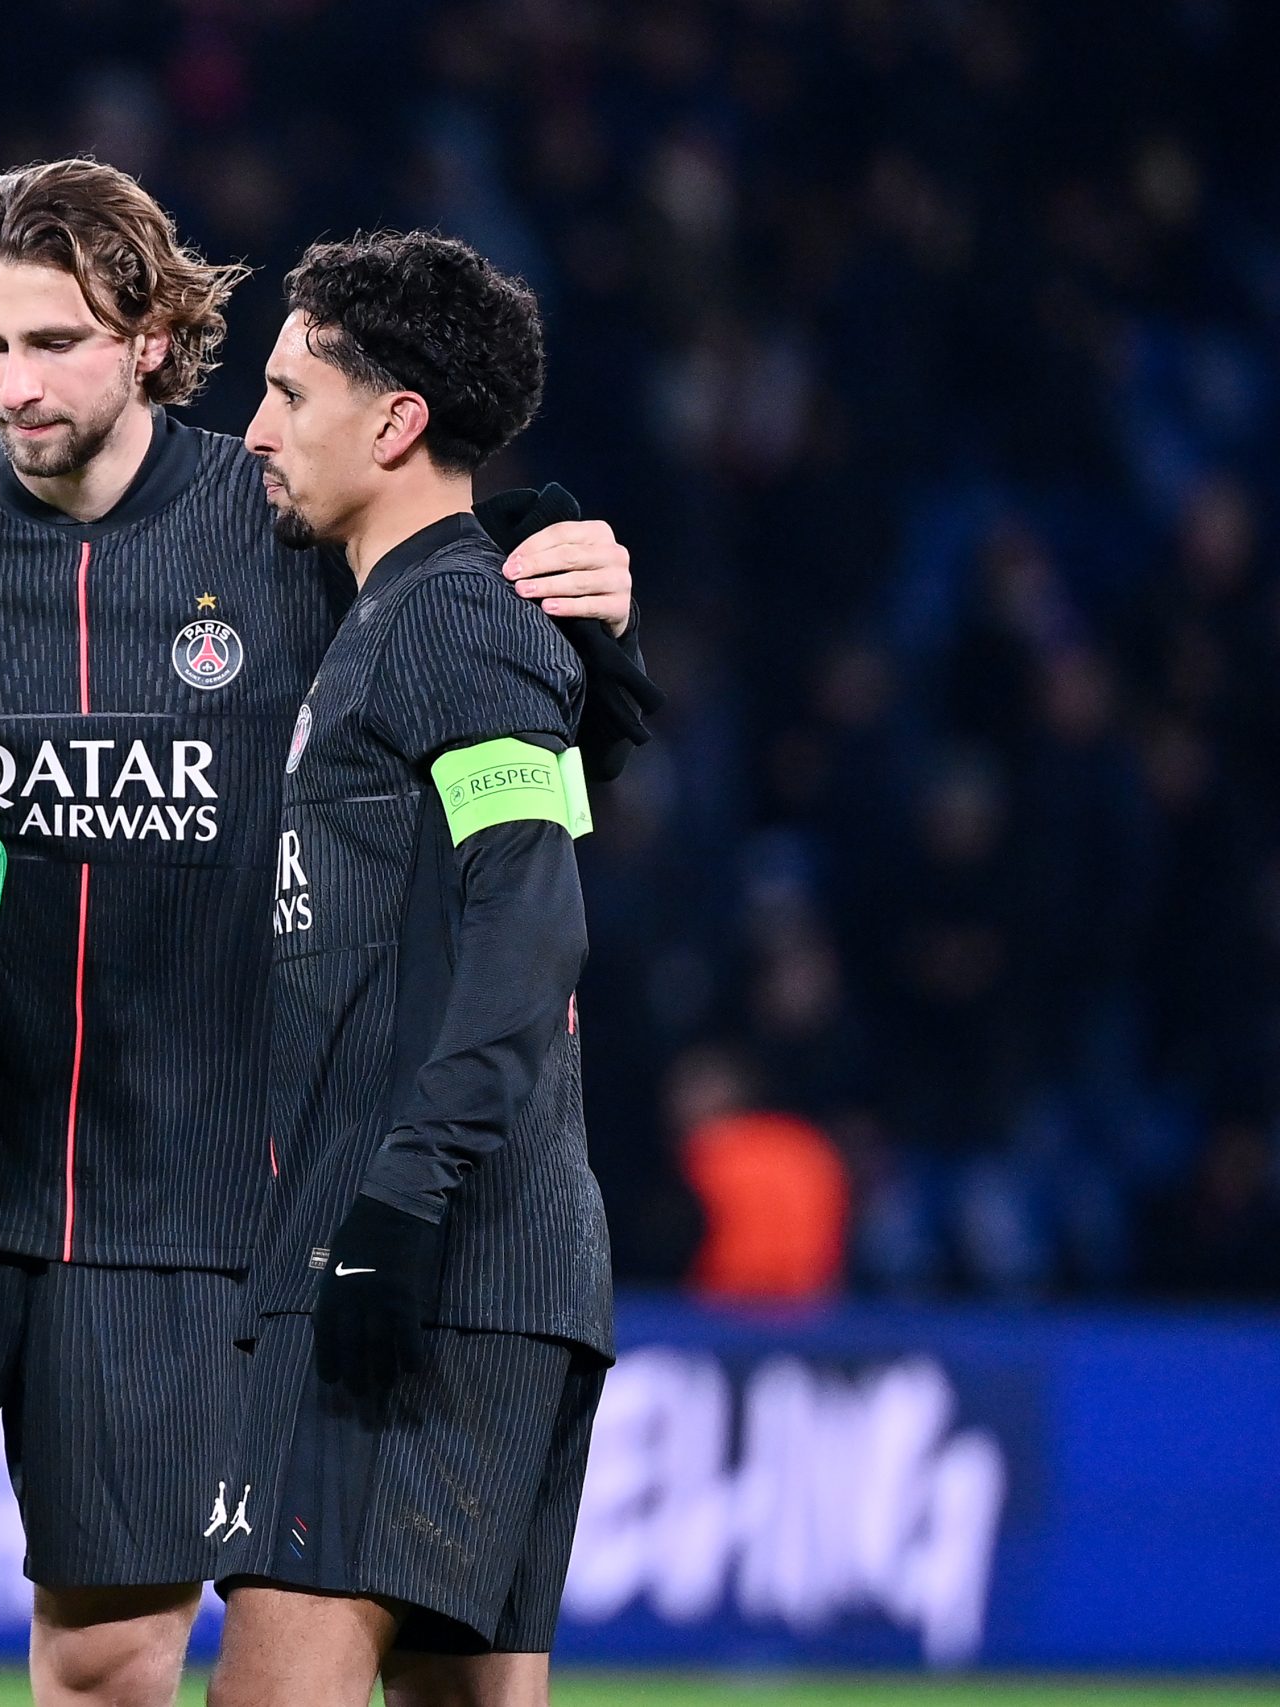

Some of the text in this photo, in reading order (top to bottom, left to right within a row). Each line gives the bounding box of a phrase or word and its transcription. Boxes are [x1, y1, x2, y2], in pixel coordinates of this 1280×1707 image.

[184, 623, 231, 640] PARIS
[470, 768, 551, 795] RESPECT
[19, 803, 218, 842] AIRWAYS
